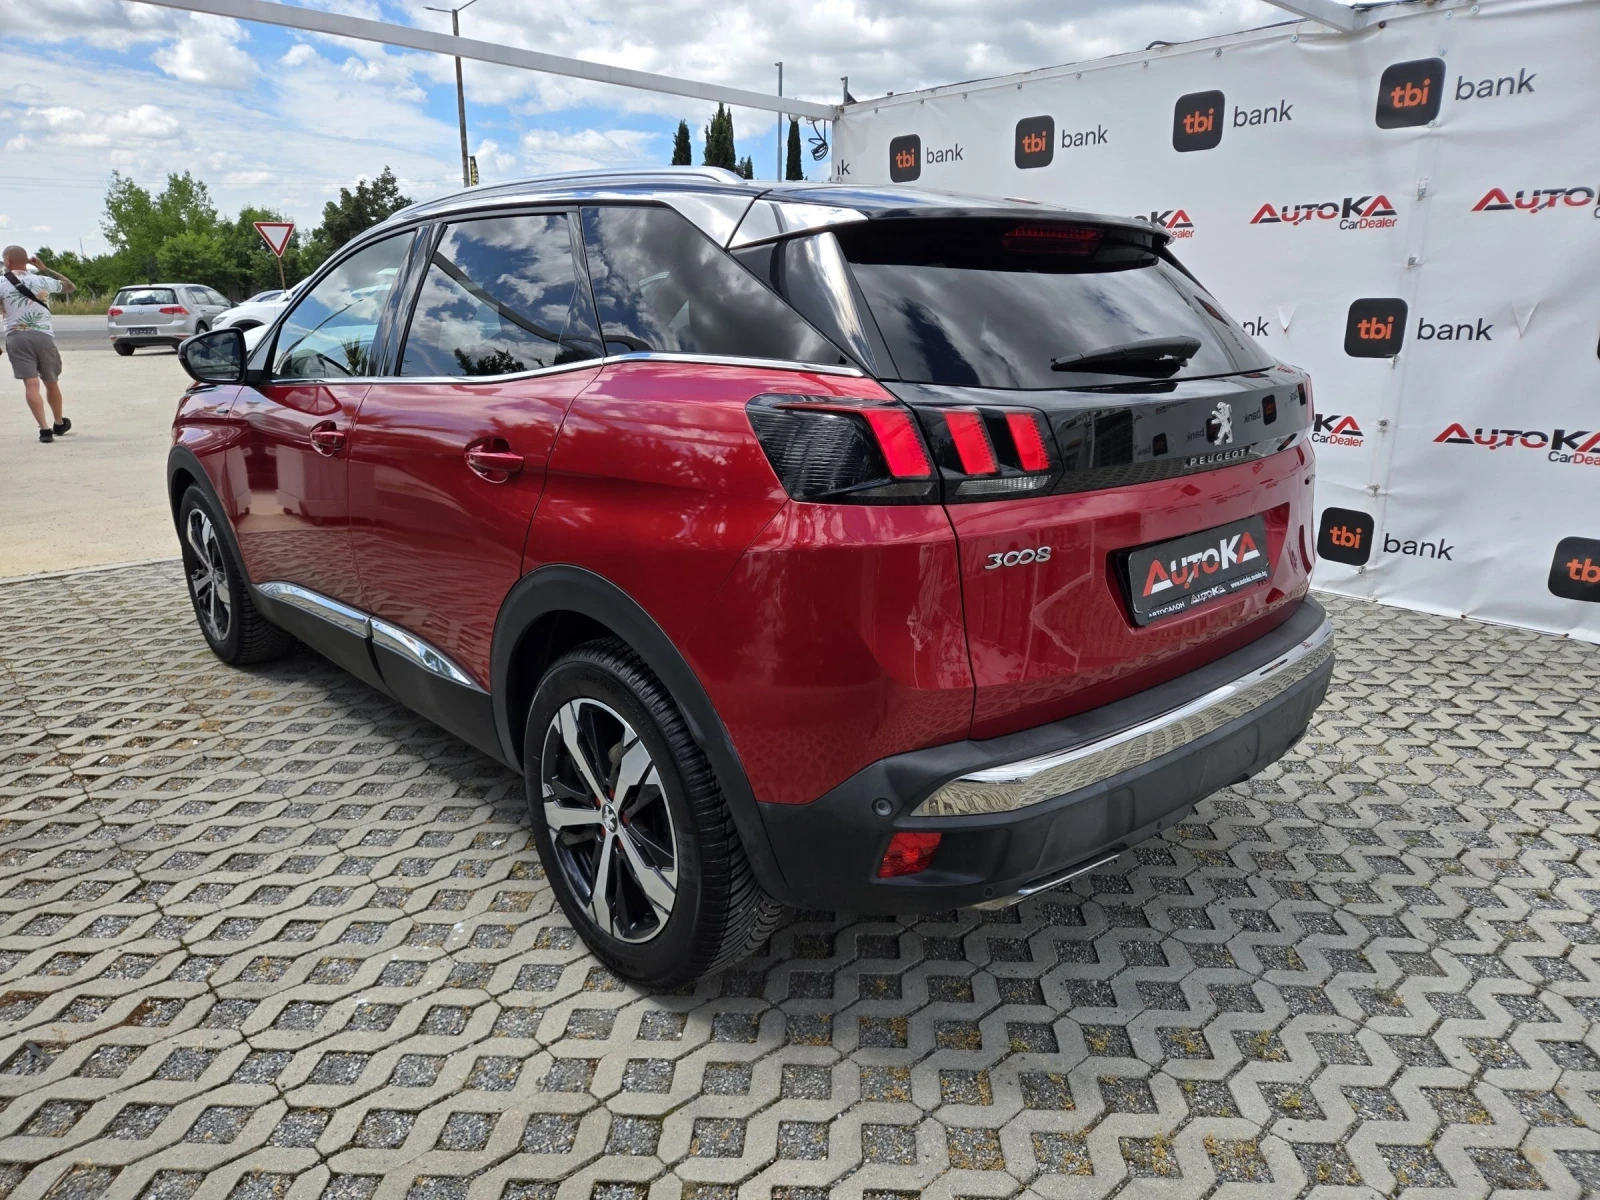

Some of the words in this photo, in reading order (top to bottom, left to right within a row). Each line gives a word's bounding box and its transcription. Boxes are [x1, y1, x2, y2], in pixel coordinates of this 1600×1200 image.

[1390, 78, 1432, 108] tbi
[1455, 67, 1538, 101] bank
[1183, 107, 1214, 134] tbi
[1233, 99, 1293, 128] bank
[1022, 130, 1047, 154] tbi
[1062, 124, 1108, 149] bank
[895, 147, 915, 169] tbi
[926, 143, 964, 165] bank
[1249, 194, 1397, 226] AUTOKA
[1471, 186, 1600, 214] AUTO
[1169, 228, 1194, 238] ealer
[1339, 217, 1397, 230] CarDealer
[1357, 315, 1395, 340] tbi
[1416, 317, 1495, 341] bank
[1311, 432, 1364, 447] CarDealer
[1189, 448, 1247, 467] PEUGEOT
[1329, 525, 1364, 549] tbi
[1383, 532, 1455, 561] bank
[984, 545, 1052, 571] 3008
[1142, 531, 1261, 597] AUTOKA
